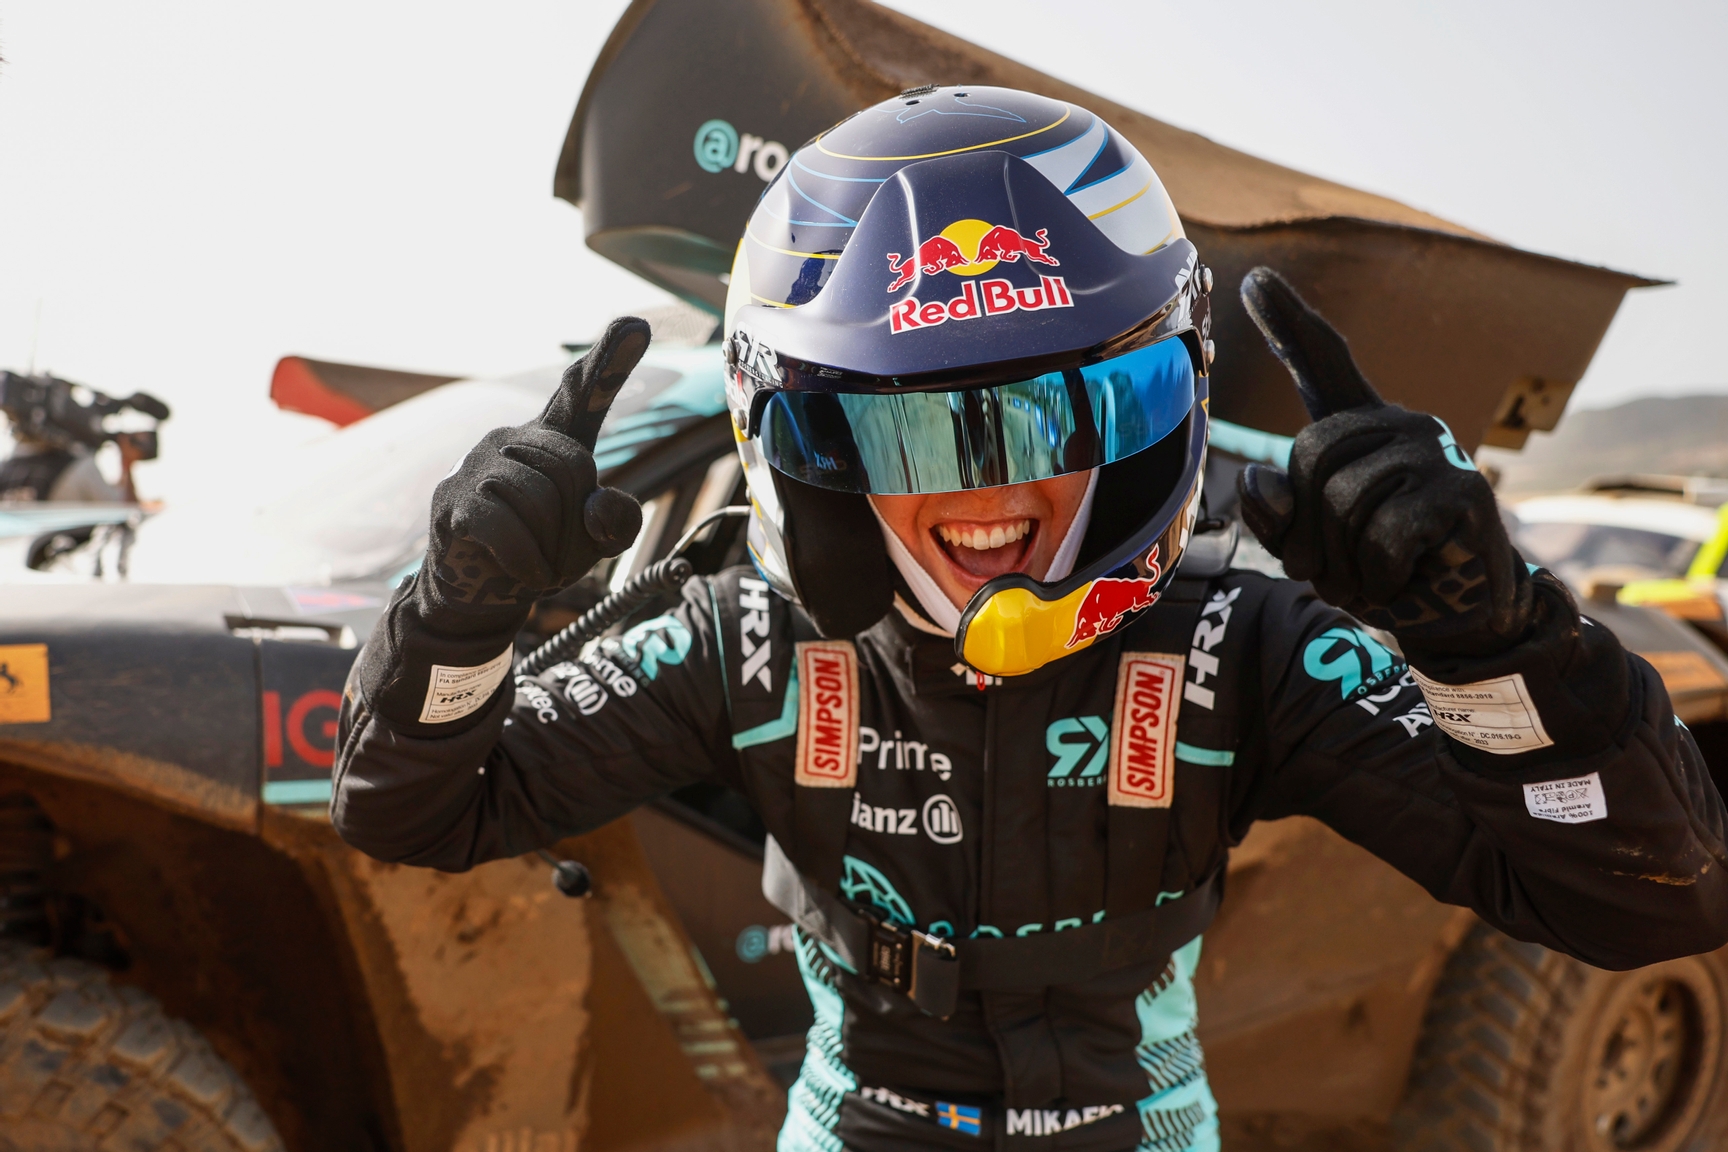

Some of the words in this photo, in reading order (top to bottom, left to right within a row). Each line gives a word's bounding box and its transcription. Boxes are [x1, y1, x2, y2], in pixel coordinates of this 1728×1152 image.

[890, 282, 979, 333] Red
[981, 275, 1072, 316] Bull
[739, 577, 772, 693] HRX
[1184, 586, 1232, 711] HRX
[439, 689, 477, 703] HRX
[813, 656, 843, 772] SIMPSON
[1126, 670, 1165, 792] SIMPSON
[1433, 708, 1471, 723] HRX
[857, 726, 952, 781] Prime
[1047, 776, 1105, 788] ROSBER
[1530, 784, 1553, 792] ITALY
[1568, 779, 1591, 787] MADE
[1568, 810, 1593, 818] 100%
